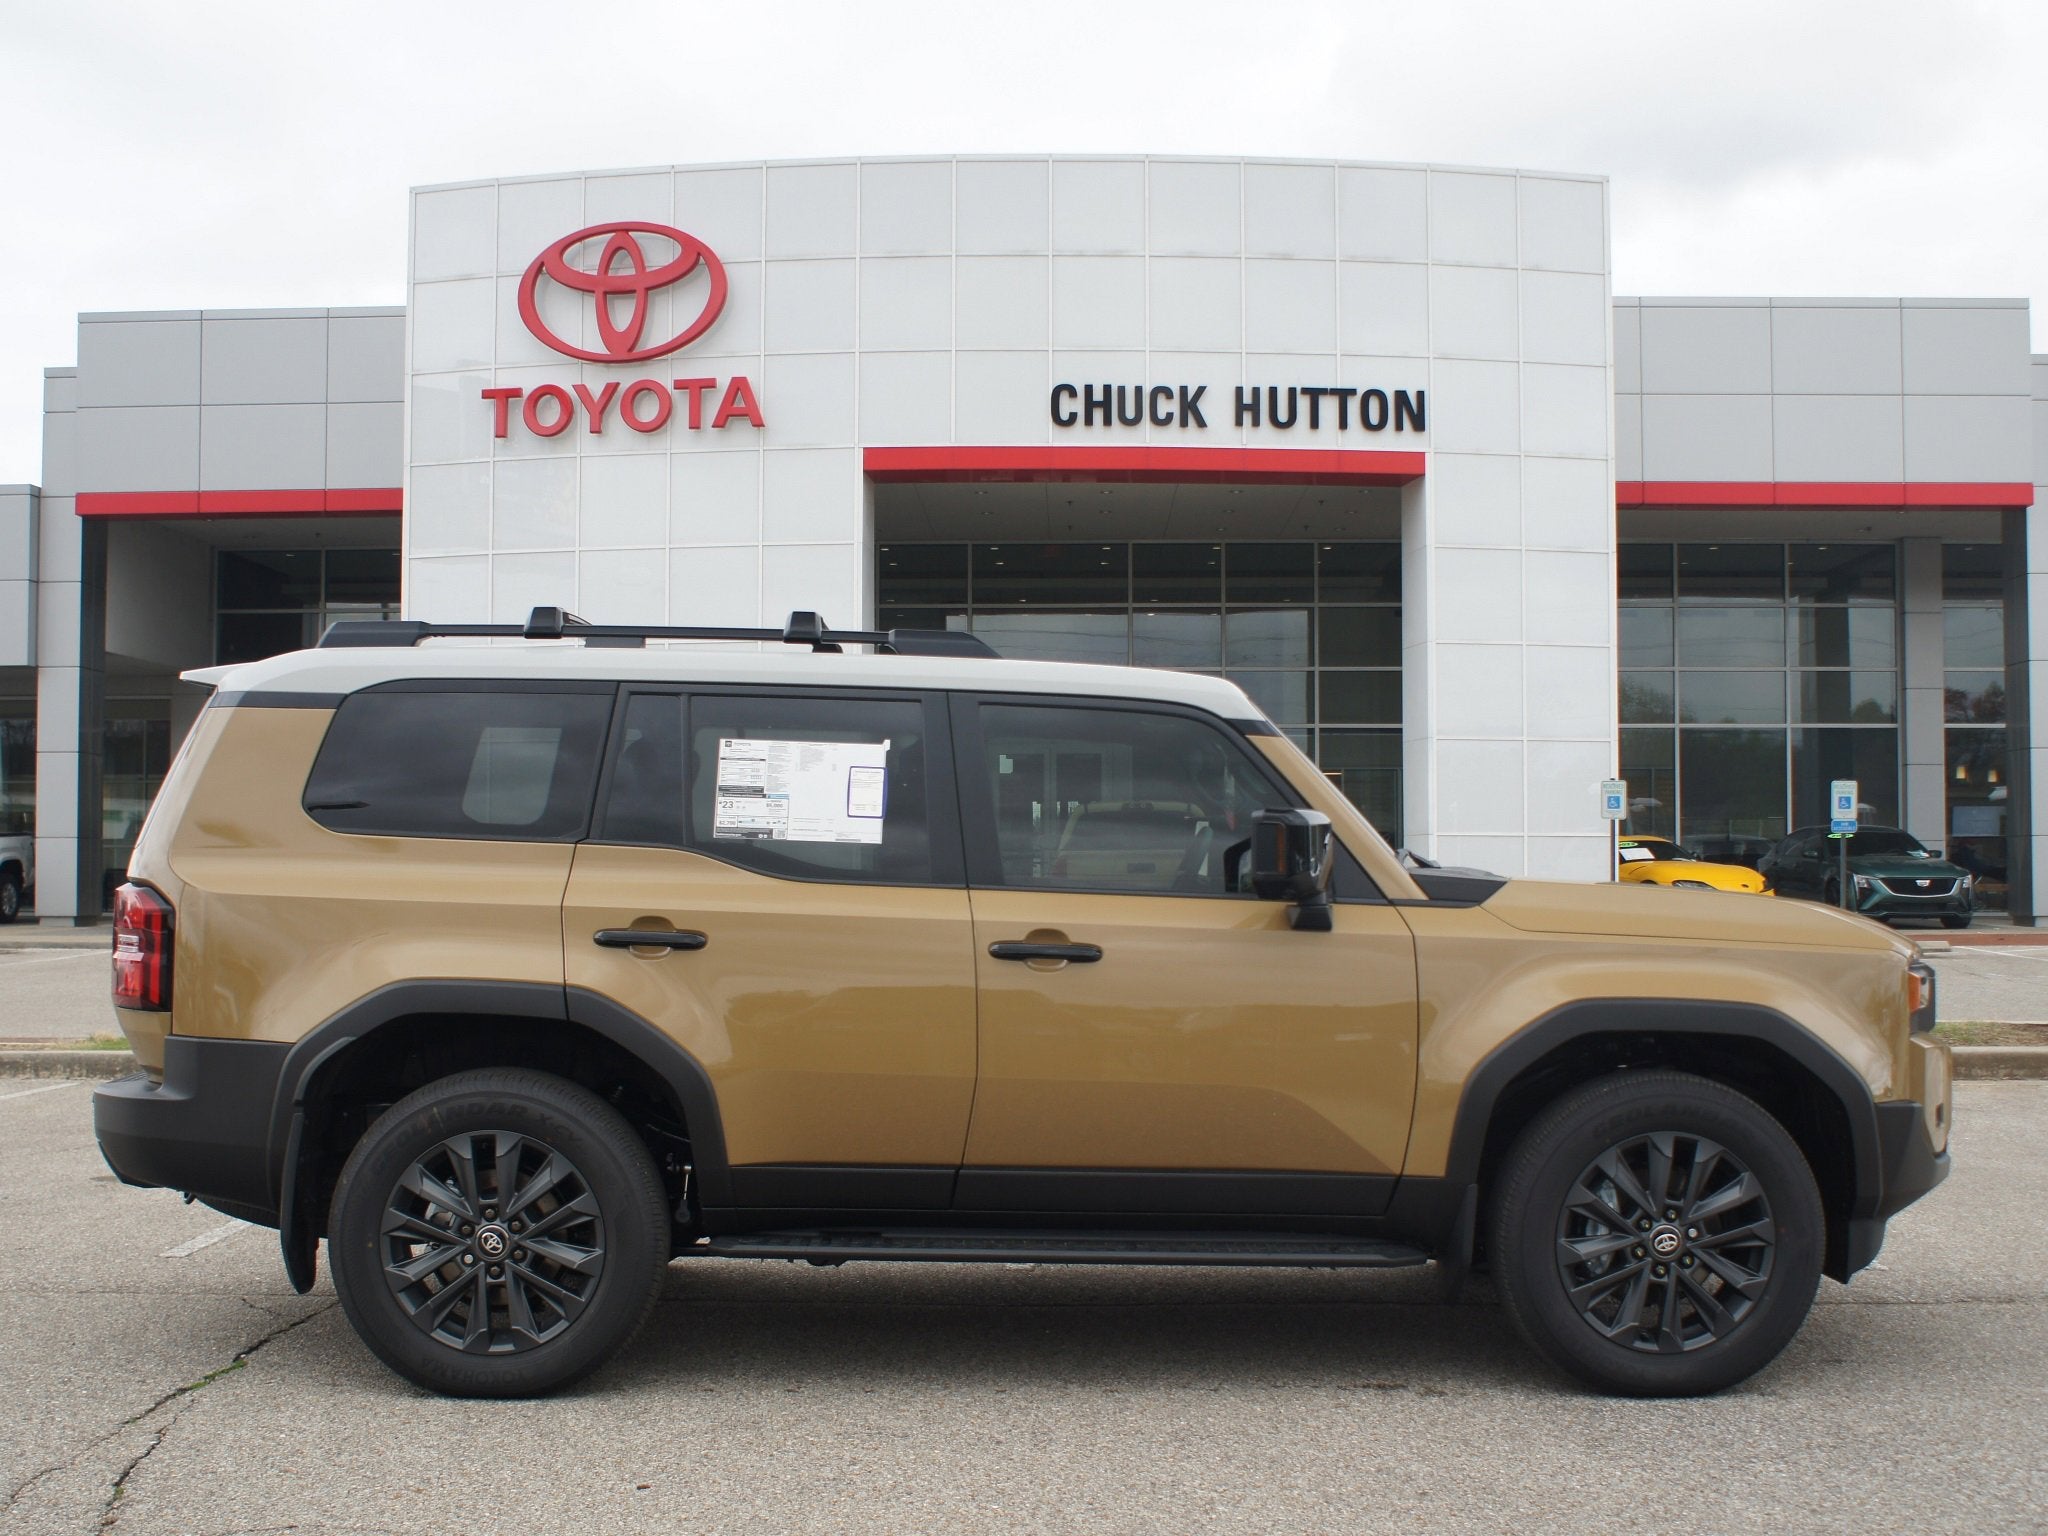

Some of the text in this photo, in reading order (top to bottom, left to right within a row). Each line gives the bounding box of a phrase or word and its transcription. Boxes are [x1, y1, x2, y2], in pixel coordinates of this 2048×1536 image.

[481, 376, 766, 439] TOYOTA
[1050, 383, 1426, 432] CHUCK HUTTON
[722, 800, 734, 809] 23
